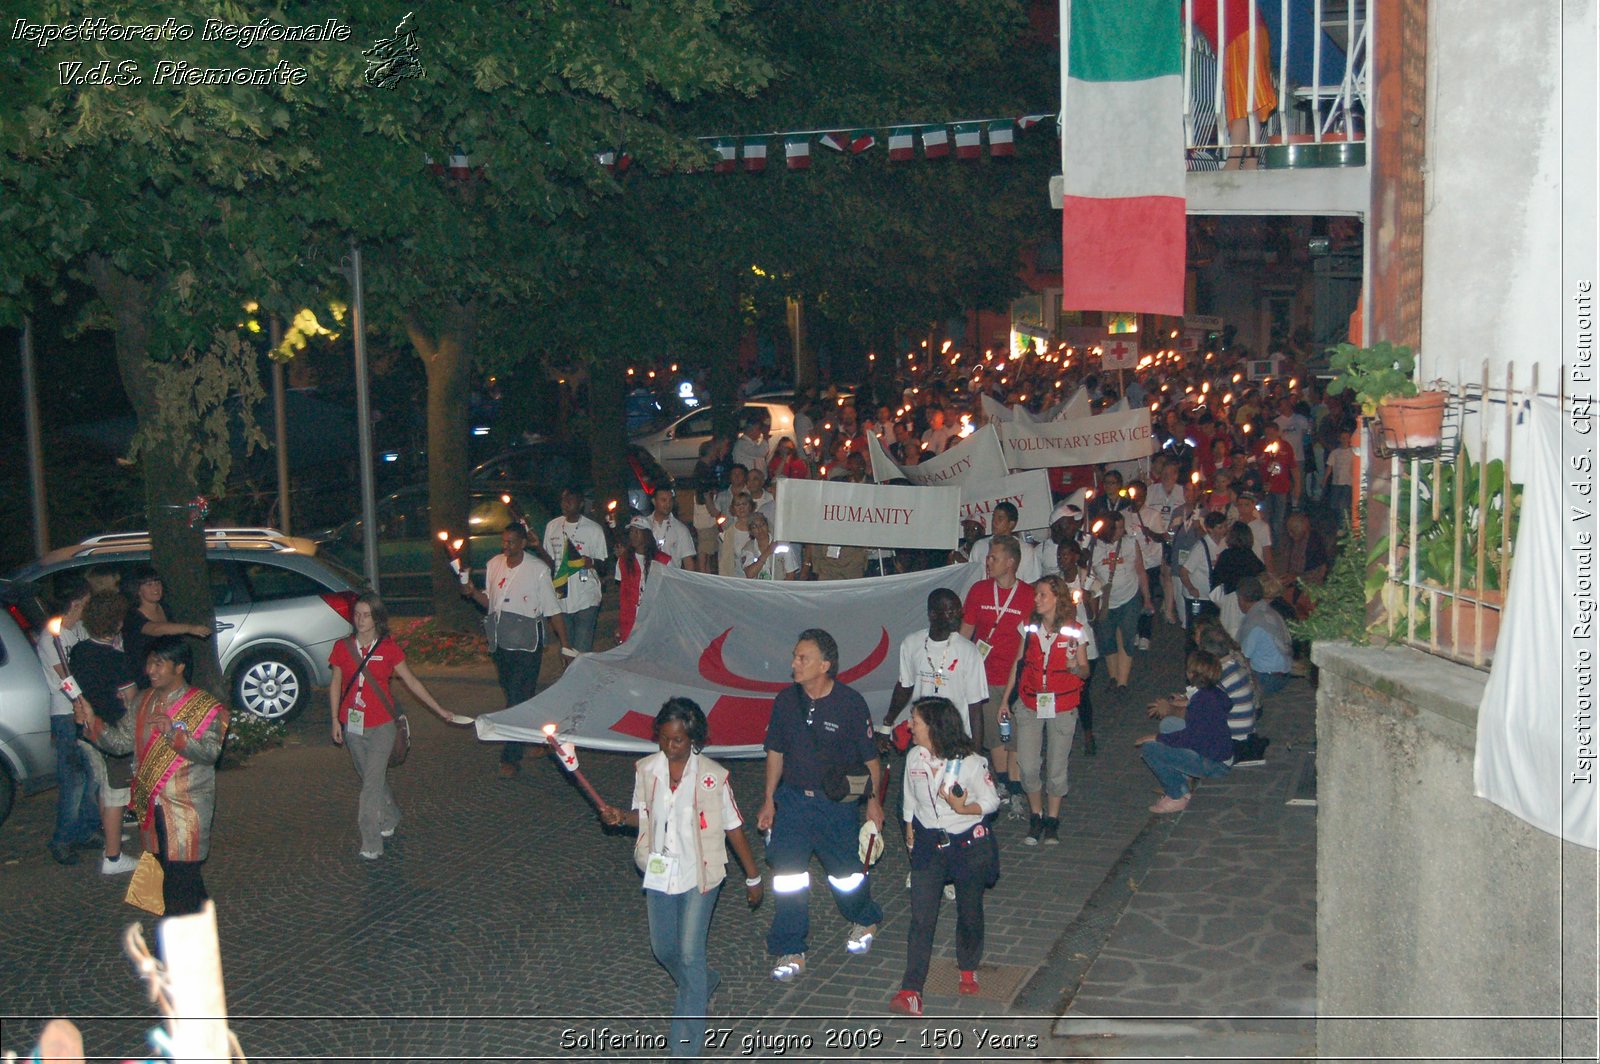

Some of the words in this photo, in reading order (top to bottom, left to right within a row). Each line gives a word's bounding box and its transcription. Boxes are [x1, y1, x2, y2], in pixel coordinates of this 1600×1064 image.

[1008, 434, 1091, 452] VOLUNTARY
[1094, 425, 1150, 446] SERVICE
[823, 504, 914, 526] HUMANITY
